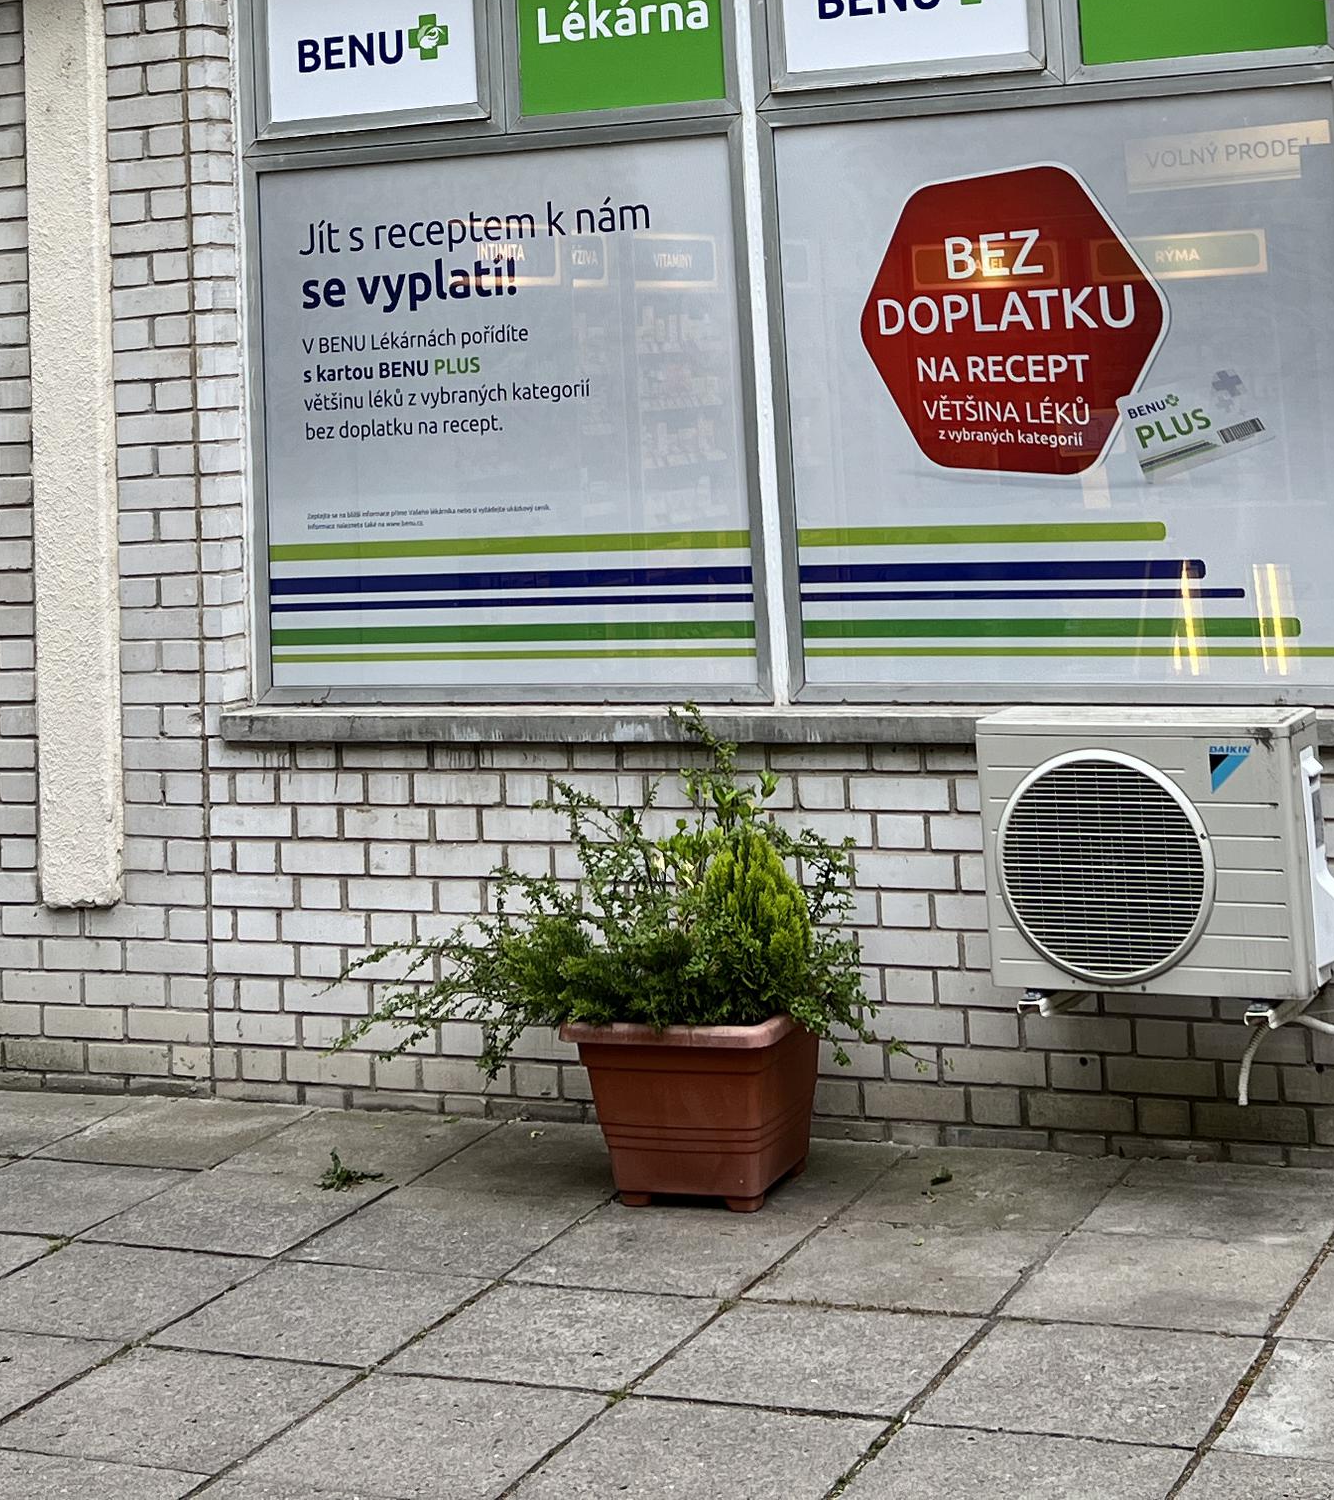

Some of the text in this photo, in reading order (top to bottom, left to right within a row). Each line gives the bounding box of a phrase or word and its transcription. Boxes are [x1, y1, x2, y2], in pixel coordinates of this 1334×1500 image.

[298, 29, 405, 73] BENU
[1147, 143, 1217, 169] VOLNÝ
[299, 196, 651, 256] Jít s receptem k nám
[477, 243, 525, 261] INTIMITA
[944, 228, 1044, 280] BEZ
[1155, 247, 1200, 263] RÝMA
[302, 254, 518, 313] se vyplatí!
[877, 284, 1136, 336] DOPLATKU
[302, 324, 529, 354] V BENU Lékárnách pořídíte
[303, 356, 481, 383] s kartou BENU PLUS
[917, 354, 1089, 383] NA RECEPT
[304, 379, 590, 412] většinu léků z vybraných kategorií
[922, 394, 1091, 425] VĚTŠINA LÉKŮ
[1127, 399, 1166, 420] BENU
[305, 414, 503, 441] bez doplatku na recept.
[938, 428, 1083, 448] z vybraných kategorií
[1135, 408, 1213, 449] PLUS
[1210, 745, 1251, 754] DAIKIN
